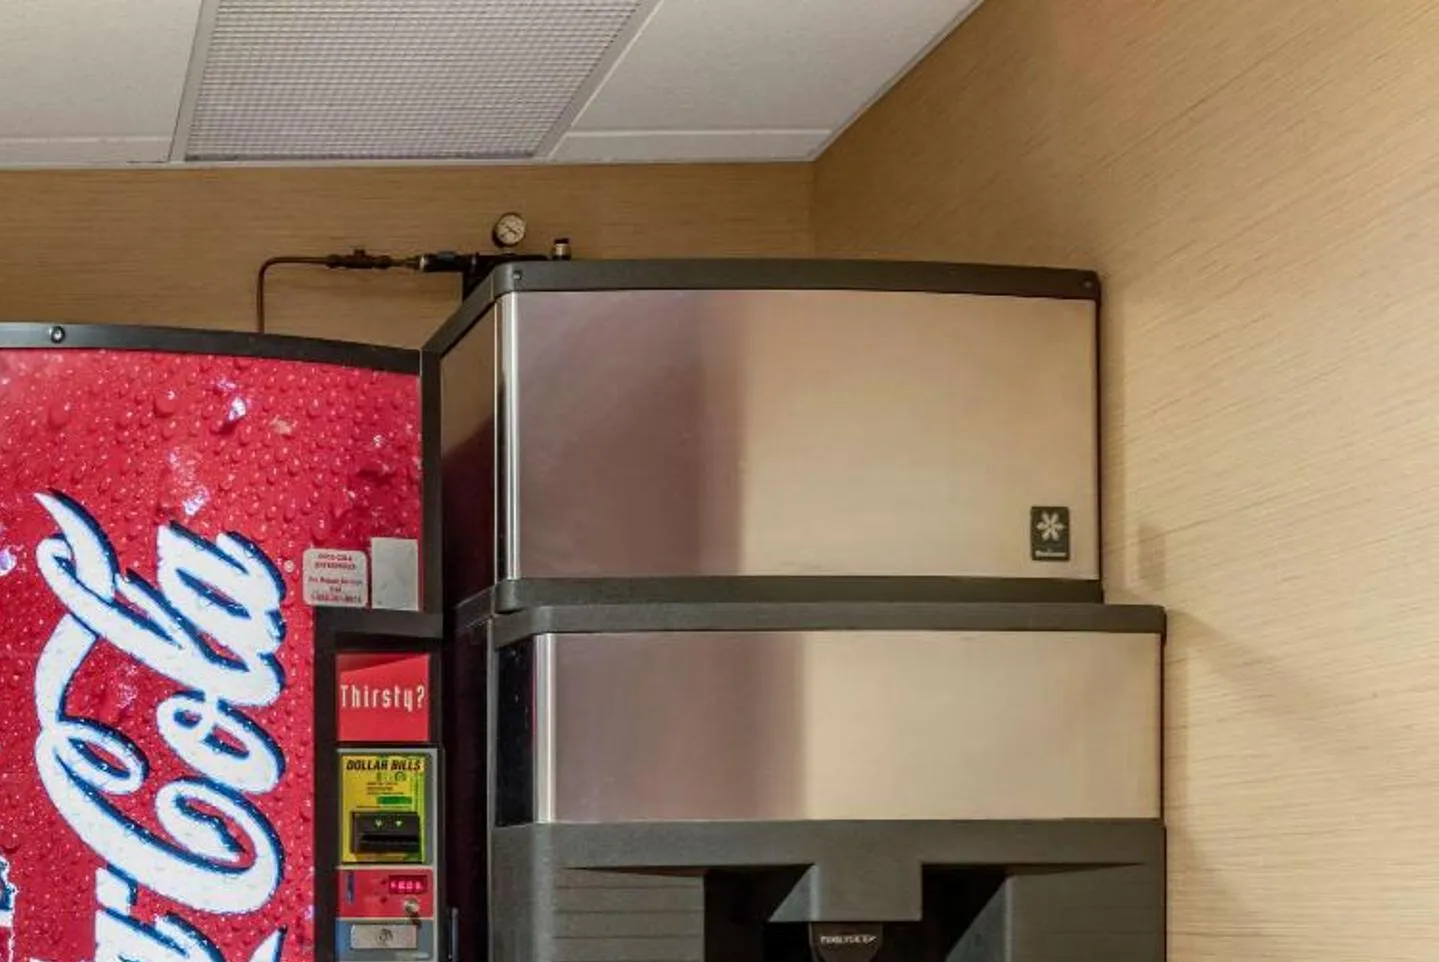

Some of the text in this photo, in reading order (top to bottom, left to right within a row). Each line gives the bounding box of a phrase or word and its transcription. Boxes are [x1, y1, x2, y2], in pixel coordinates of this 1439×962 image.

[340, 684, 425, 713] Thirsty?
[346, 758, 422, 771] DOLLAR BILLS
